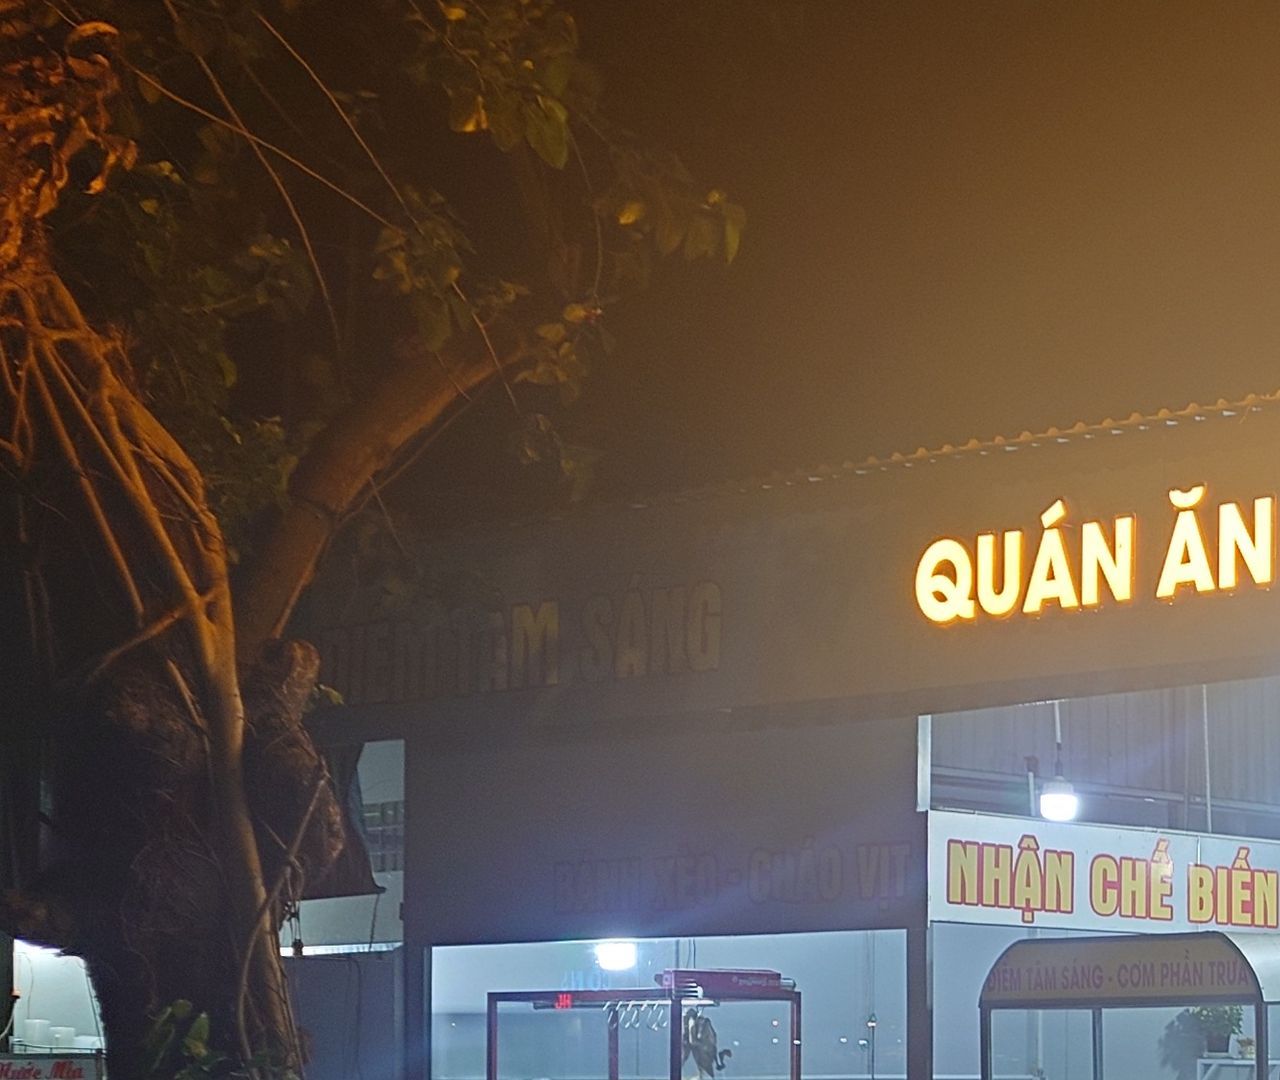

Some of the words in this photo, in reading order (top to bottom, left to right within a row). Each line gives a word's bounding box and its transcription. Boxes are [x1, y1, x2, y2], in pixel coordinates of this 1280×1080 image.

[914, 500, 1133, 623] QUÁN
[1155, 486, 1273, 598] ĂN
[580, 573, 723, 684] SÁNG
[946, 834, 1074, 923] NHẬN
[1090, 838, 1174, 921] CHẾ
[1188, 847, 1279, 929] BIẾN
[1025, 960, 1056, 990] TÂM
[1061, 958, 1103, 990] SÁNG
[1117, 960, 1156, 989] CƠM
[1160, 948, 1203, 988] PHẦN
[1208, 958, 1250, 986] TRƯA
